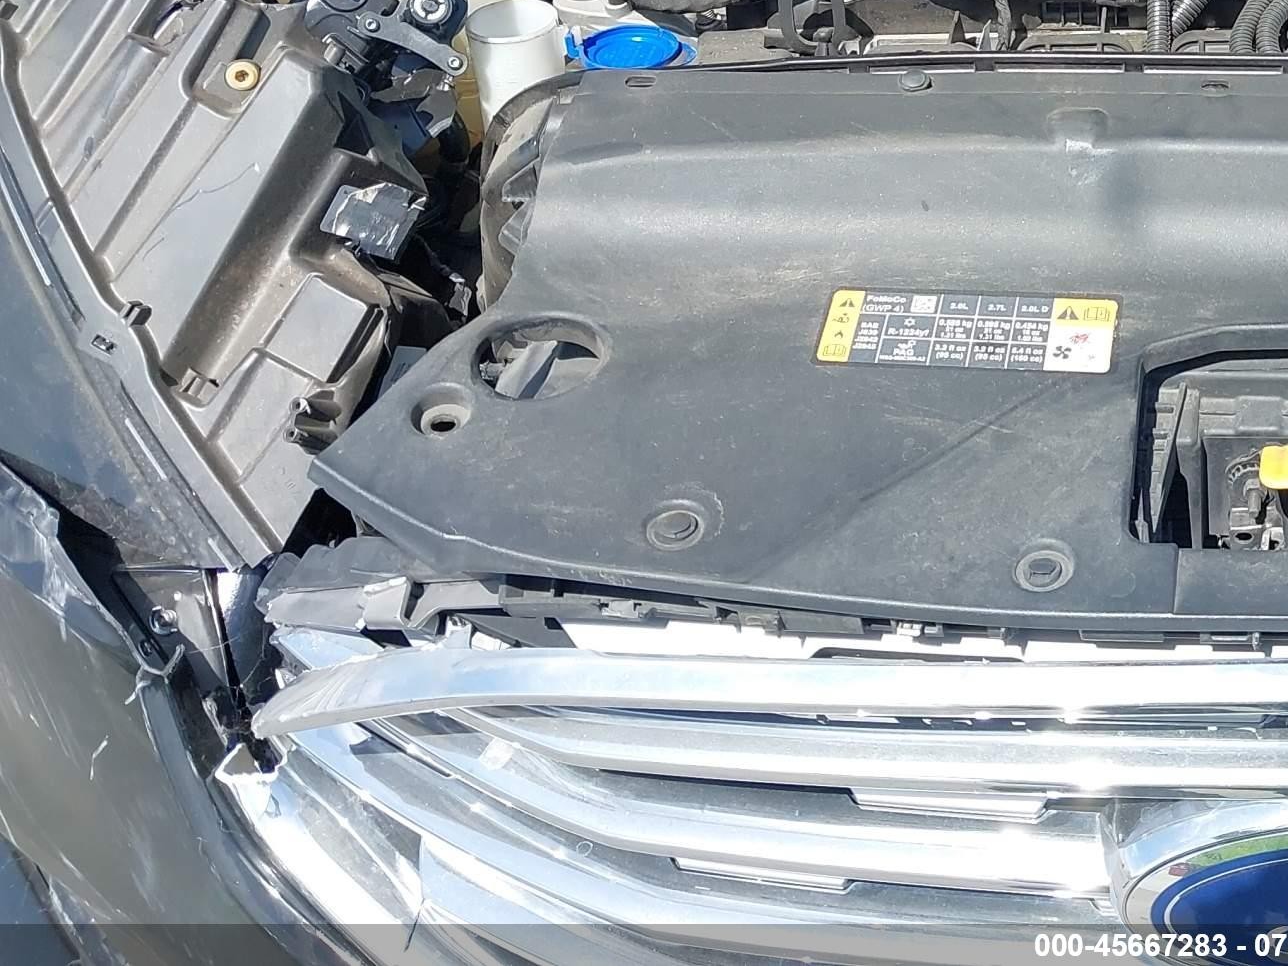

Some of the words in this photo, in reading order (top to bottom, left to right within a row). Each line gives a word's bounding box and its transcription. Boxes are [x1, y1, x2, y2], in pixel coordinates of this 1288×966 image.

[866, 295, 907, 303] FoMoCo
[862, 303, 892, 312] (GWP
[893, 305, 905, 313] 4)
